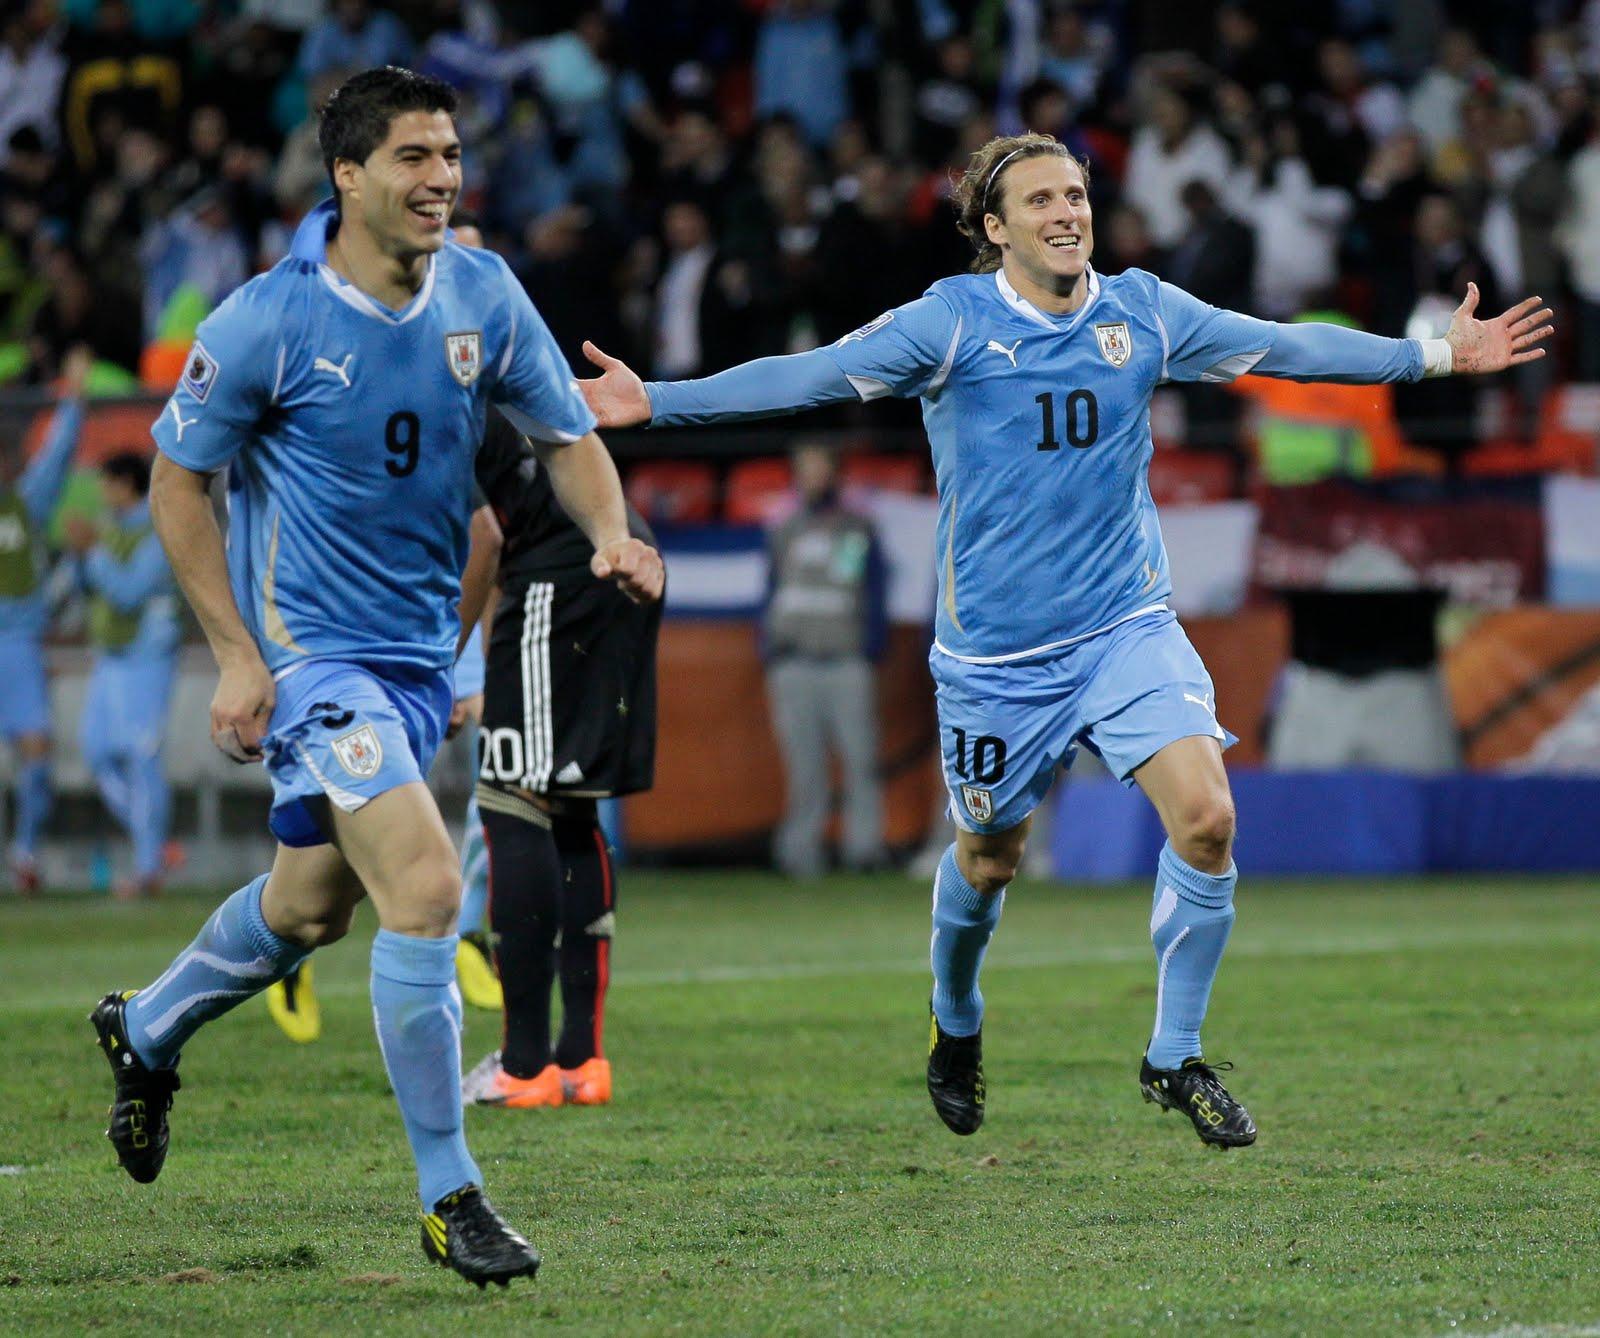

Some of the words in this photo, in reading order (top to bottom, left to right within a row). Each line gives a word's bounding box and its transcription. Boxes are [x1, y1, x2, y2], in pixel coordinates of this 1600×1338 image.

[384, 411, 420, 479] 9
[1035, 389, 1099, 451] 10
[479, 726, 524, 782] 20
[952, 727, 1007, 784] 10
